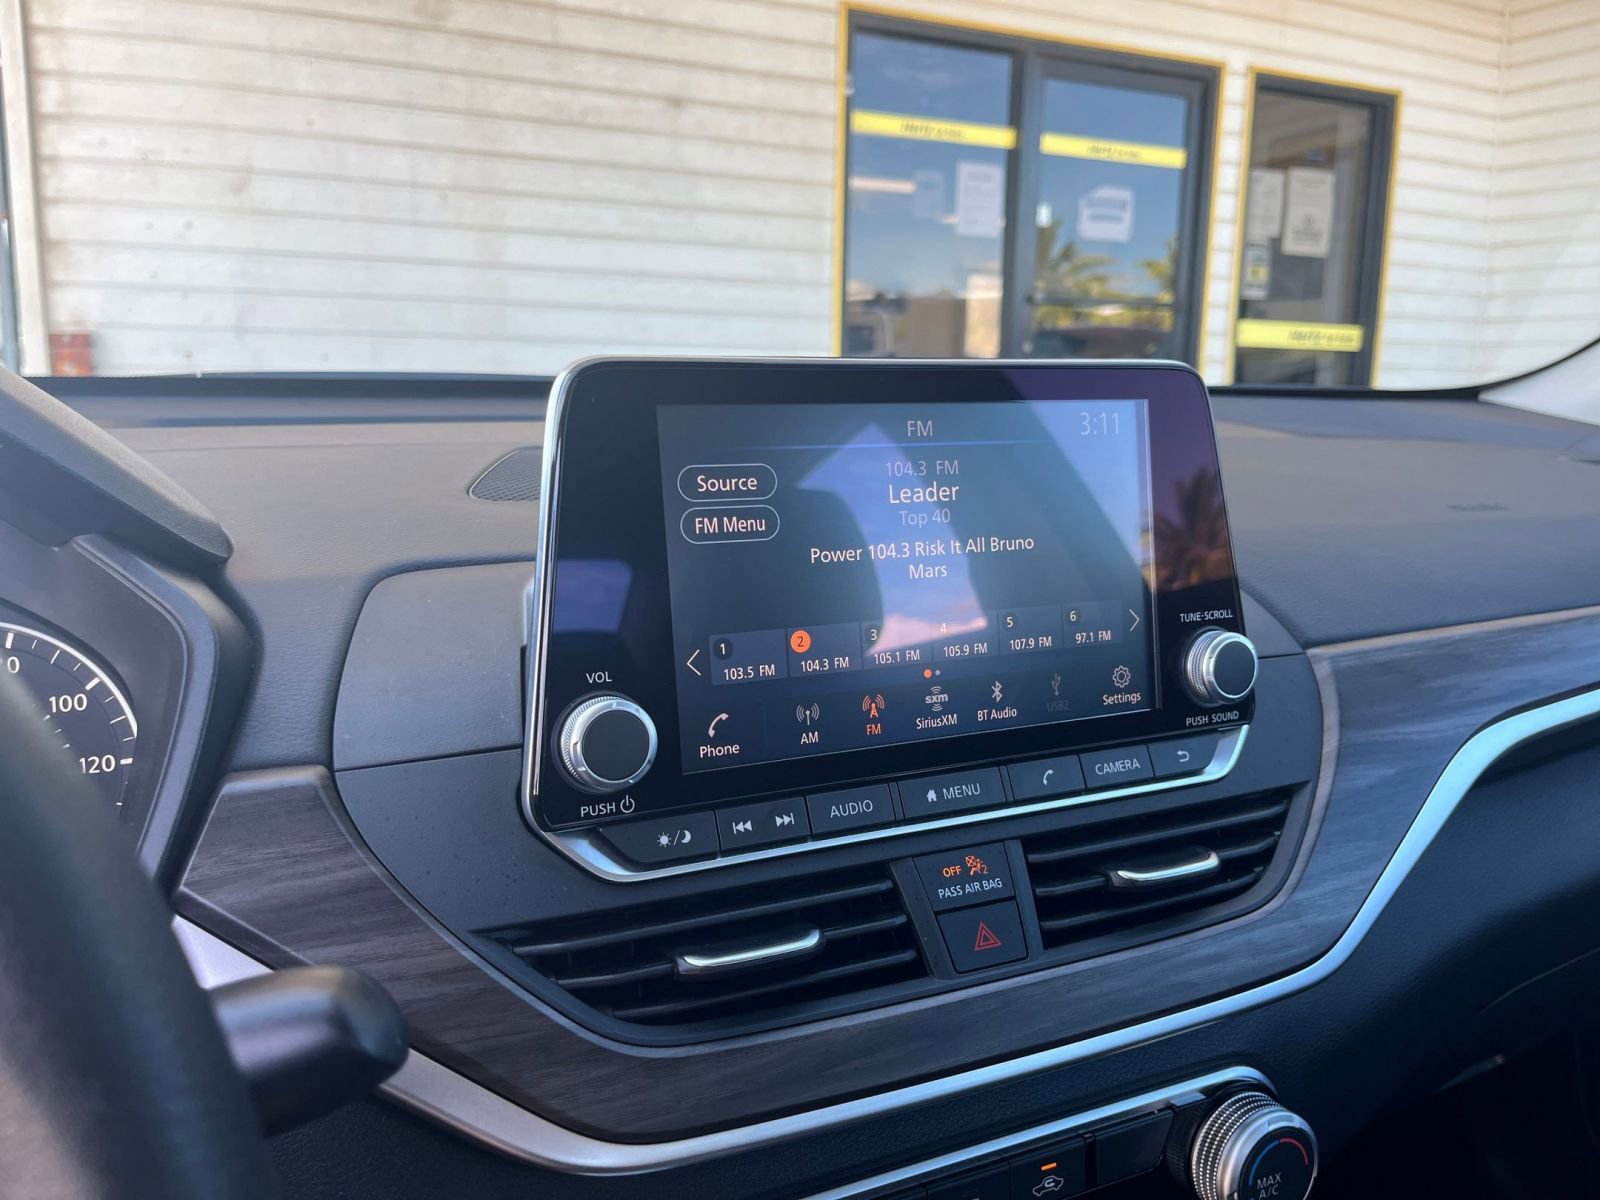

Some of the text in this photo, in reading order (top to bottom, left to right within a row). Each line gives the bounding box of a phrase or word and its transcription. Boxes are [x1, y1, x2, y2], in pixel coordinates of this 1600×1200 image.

[907, 420, 934, 437] FM
[1079, 412, 1120, 435] 3:11
[886, 460, 959, 477] 104.3 FM
[697, 475, 758, 492] Source
[889, 482, 960, 504] Leader
[695, 516, 766, 534] FM Menu
[899, 509, 951, 528] Top 40
[810, 536, 1035, 563] Power 104.3 Risk It All Bruno
[909, 564, 948, 579] Mars
[1006, 617, 1014, 628] 5
[1069, 611, 1077, 622] 6
[869, 629, 878, 641] 3
[939, 623, 948, 634] 4
[1009, 637, 1053, 651] 107.9 FM
[1075, 630, 1112, 644] 97.1 FM
[874, 649, 921, 664] 105.1 FM
[943, 643, 988, 658] 105.9 FM
[723, 664, 776, 681] 103.5 FM
[800, 656, 850, 673] 104.3 FM
[586, 672, 612, 683] VOL
[49, 694, 87, 712] 100
[1103, 692, 1141, 705] Settings
[915, 713, 958, 730] SiriusXM
[977, 706, 1018, 722] BT Audio
[1185, 711, 1239, 727] PUSH SOUND
[866, 723, 882, 736] FM
[800, 731, 819, 745] AM
[699, 743, 740, 759] Phone
[79, 755, 116, 774] 120
[1095, 758, 1141, 775] CAMERA
[943, 783, 981, 800] MENU
[580, 803, 617, 818] PUSH
[830, 800, 873, 818] AUDIO
[942, 865, 962, 878] OFF
[937, 877, 1003, 900] PASS AIR BAG
[1257, 1172, 1282, 1189] MAX
[1259, 1184, 1278, 1200] A/C
